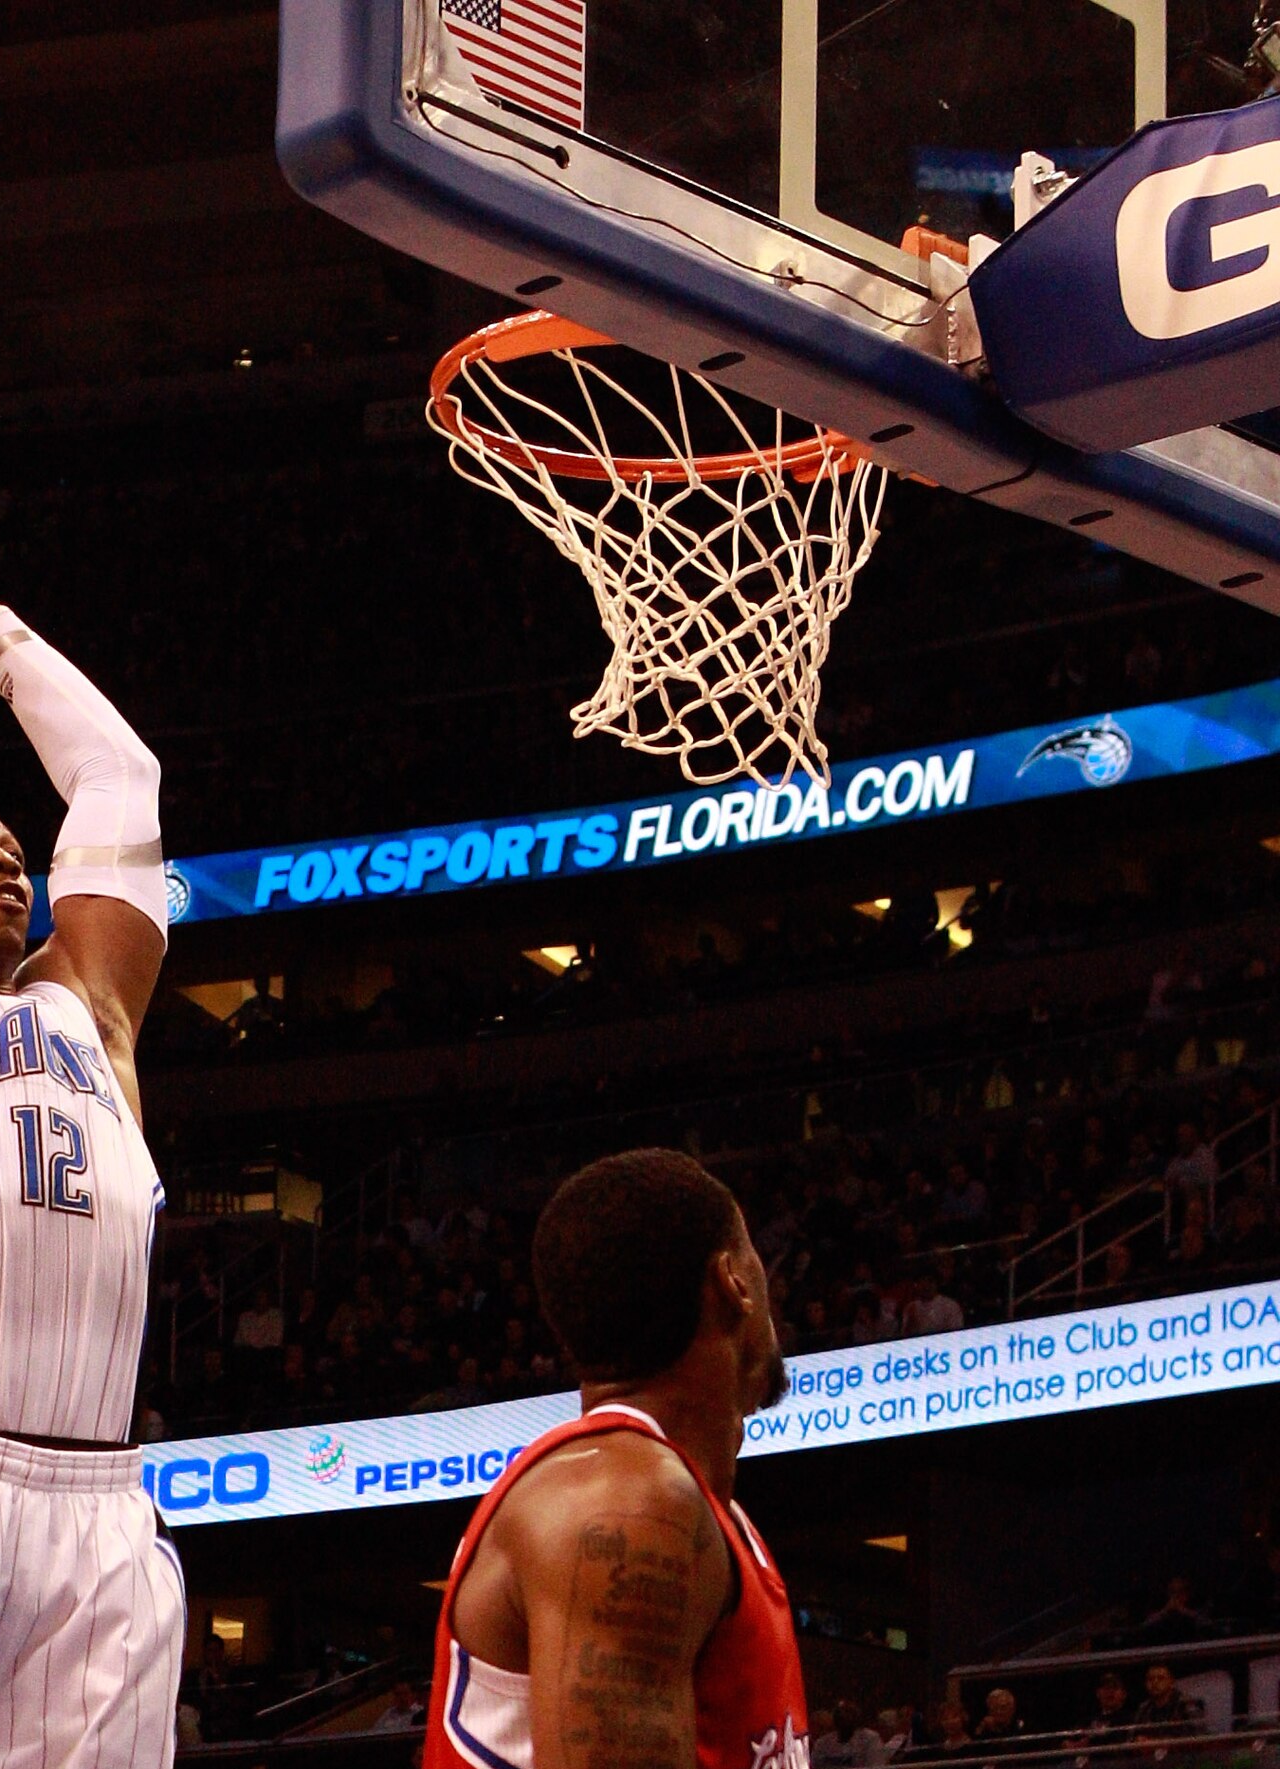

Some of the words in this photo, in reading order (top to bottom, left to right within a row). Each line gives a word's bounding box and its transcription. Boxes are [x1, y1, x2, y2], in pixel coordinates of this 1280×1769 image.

[10, 1104, 94, 1219] 12
[747, 1414, 790, 1441] ow
[798, 1406, 850, 1439] you
[860, 1397, 915, 1425] can
[926, 1373, 1064, 1422] purchase
[1076, 1347, 1212, 1400] products
[791, 1366, 863, 1397] ierge
[873, 1349, 950, 1384] desks
[960, 1345, 997, 1370] on
[1008, 1332, 1055, 1363] the
[1066, 1316, 1137, 1354] Club
[1149, 1304, 1211, 1341] and
